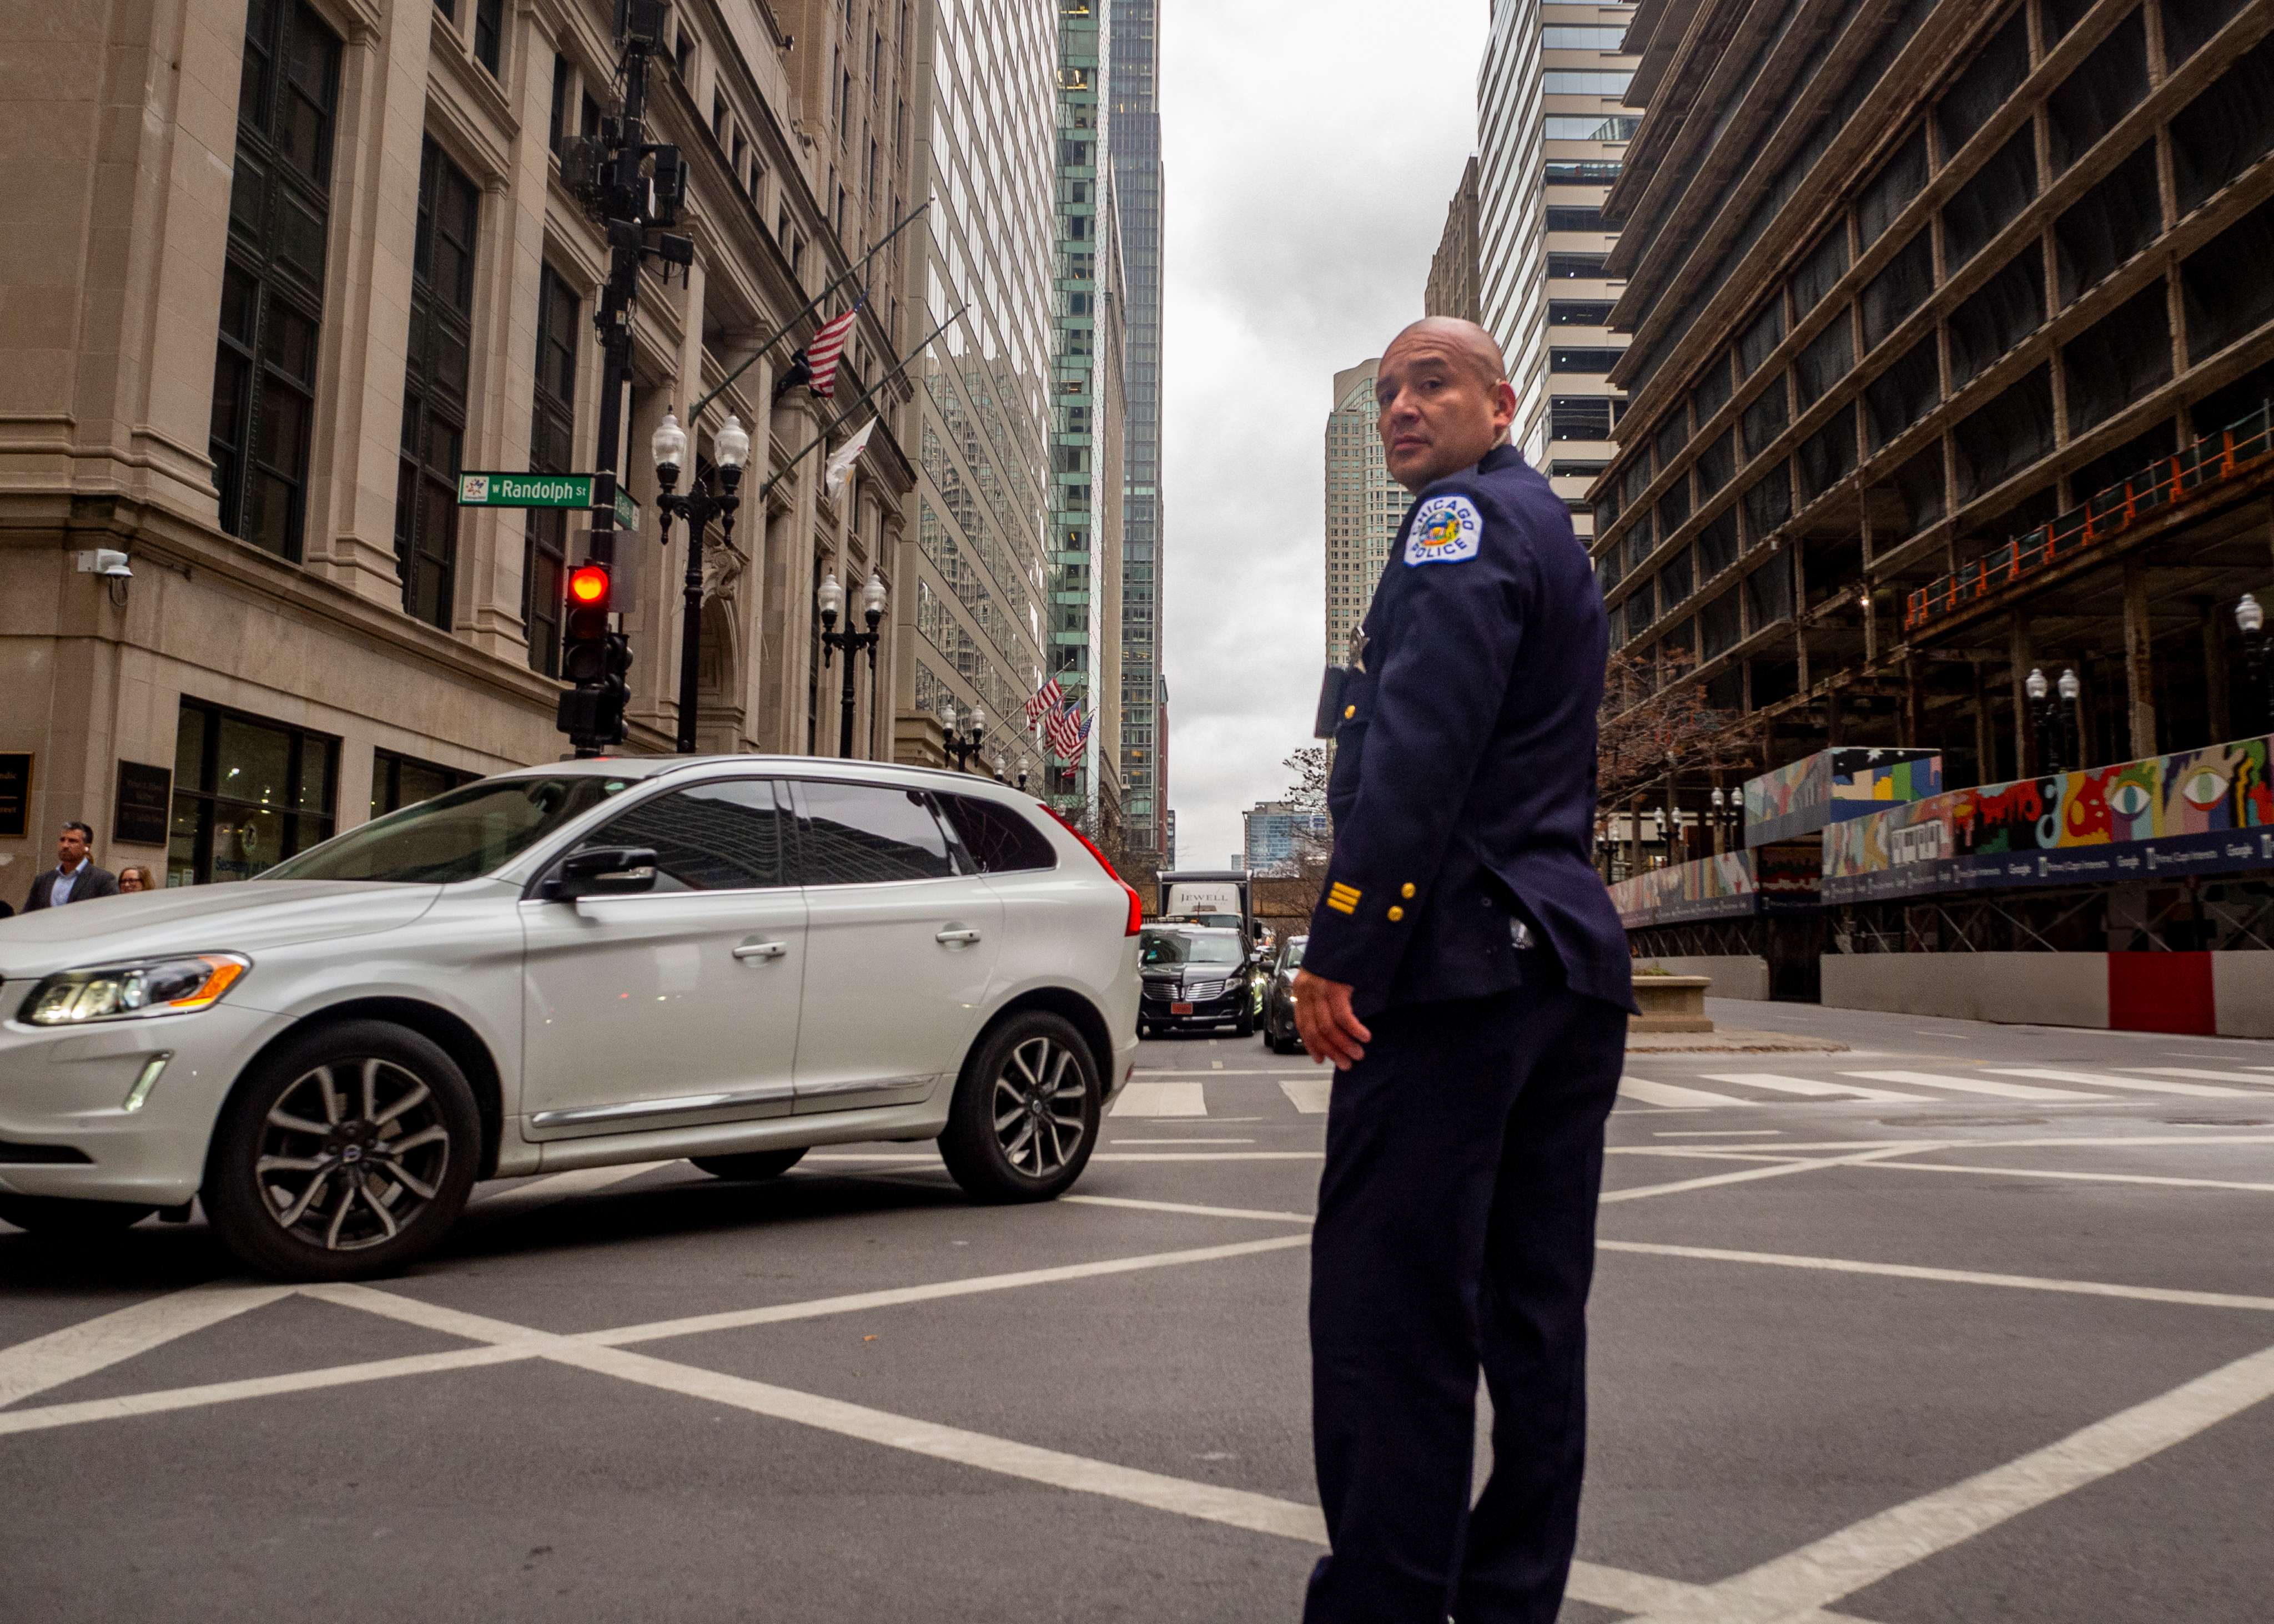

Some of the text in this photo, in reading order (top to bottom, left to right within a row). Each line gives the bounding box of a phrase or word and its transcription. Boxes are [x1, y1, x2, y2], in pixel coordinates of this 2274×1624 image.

[492, 480, 586, 503] W Randolph St
[1412, 538, 1467, 558] POLICE
[1181, 894, 1228, 902] JEWELL
